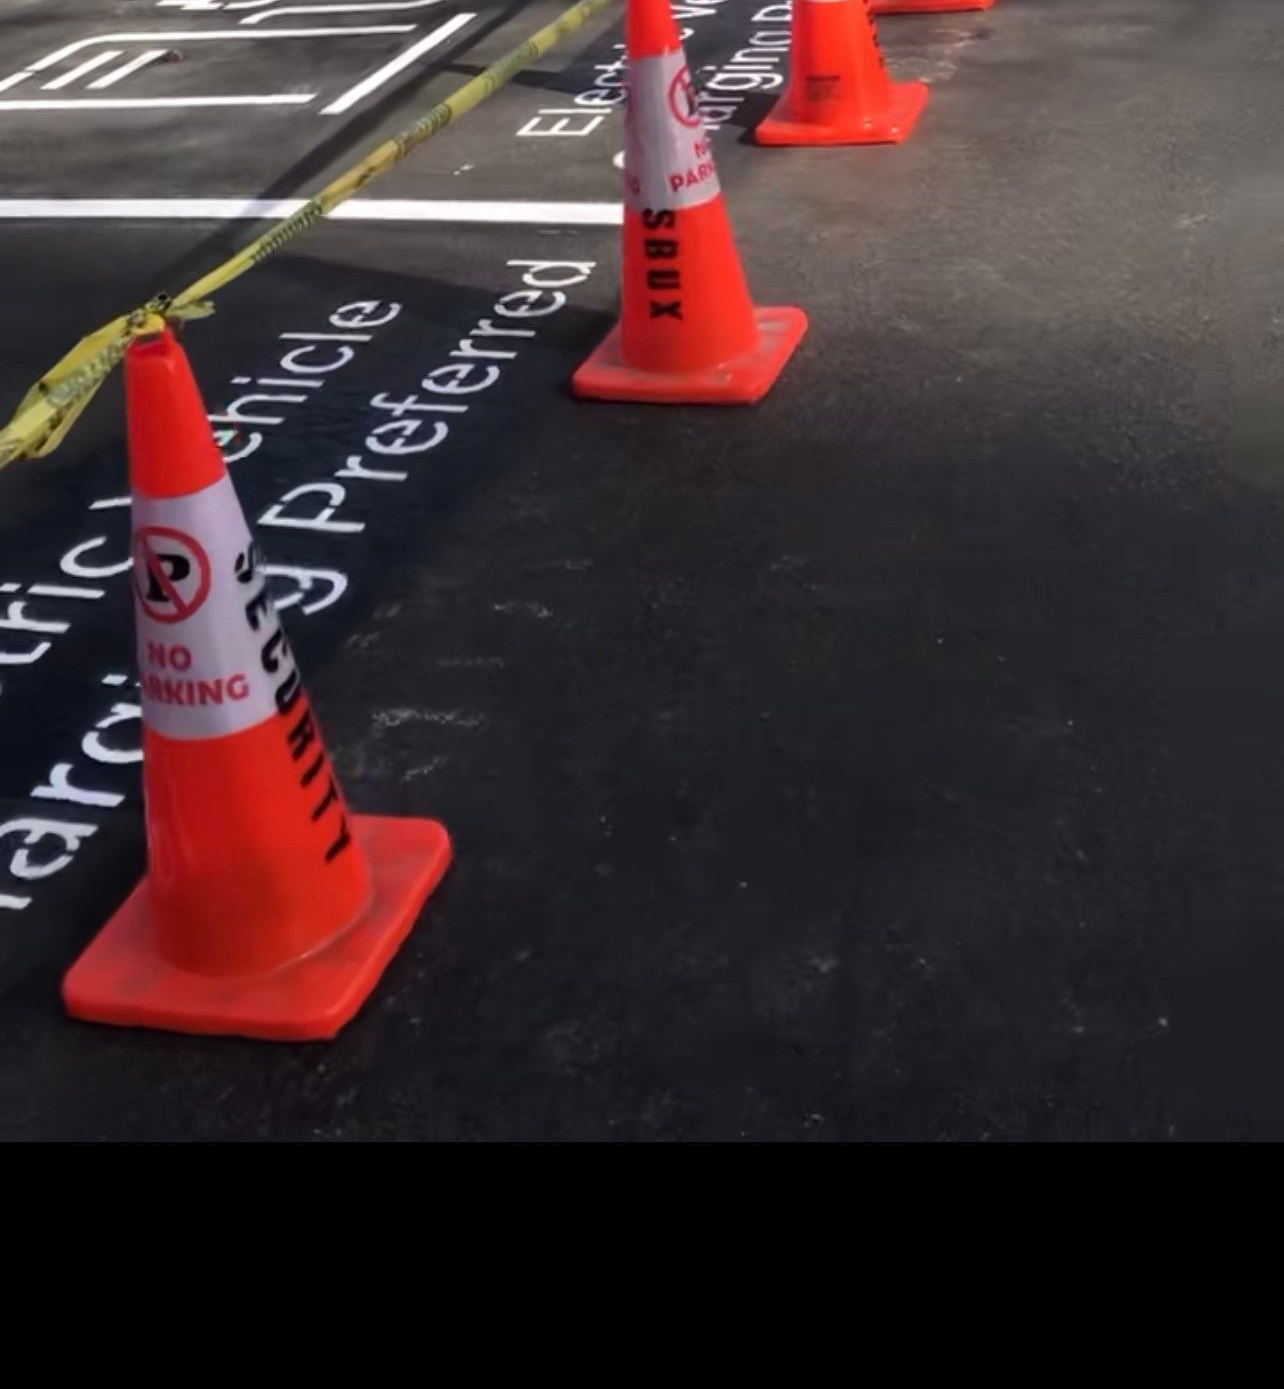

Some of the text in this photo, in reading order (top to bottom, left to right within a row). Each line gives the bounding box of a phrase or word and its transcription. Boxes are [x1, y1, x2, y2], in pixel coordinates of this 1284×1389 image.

[642, 207, 683, 321] SBUX
[257, 259, 597, 533] Preferred
[148, 643, 192, 671] NO
